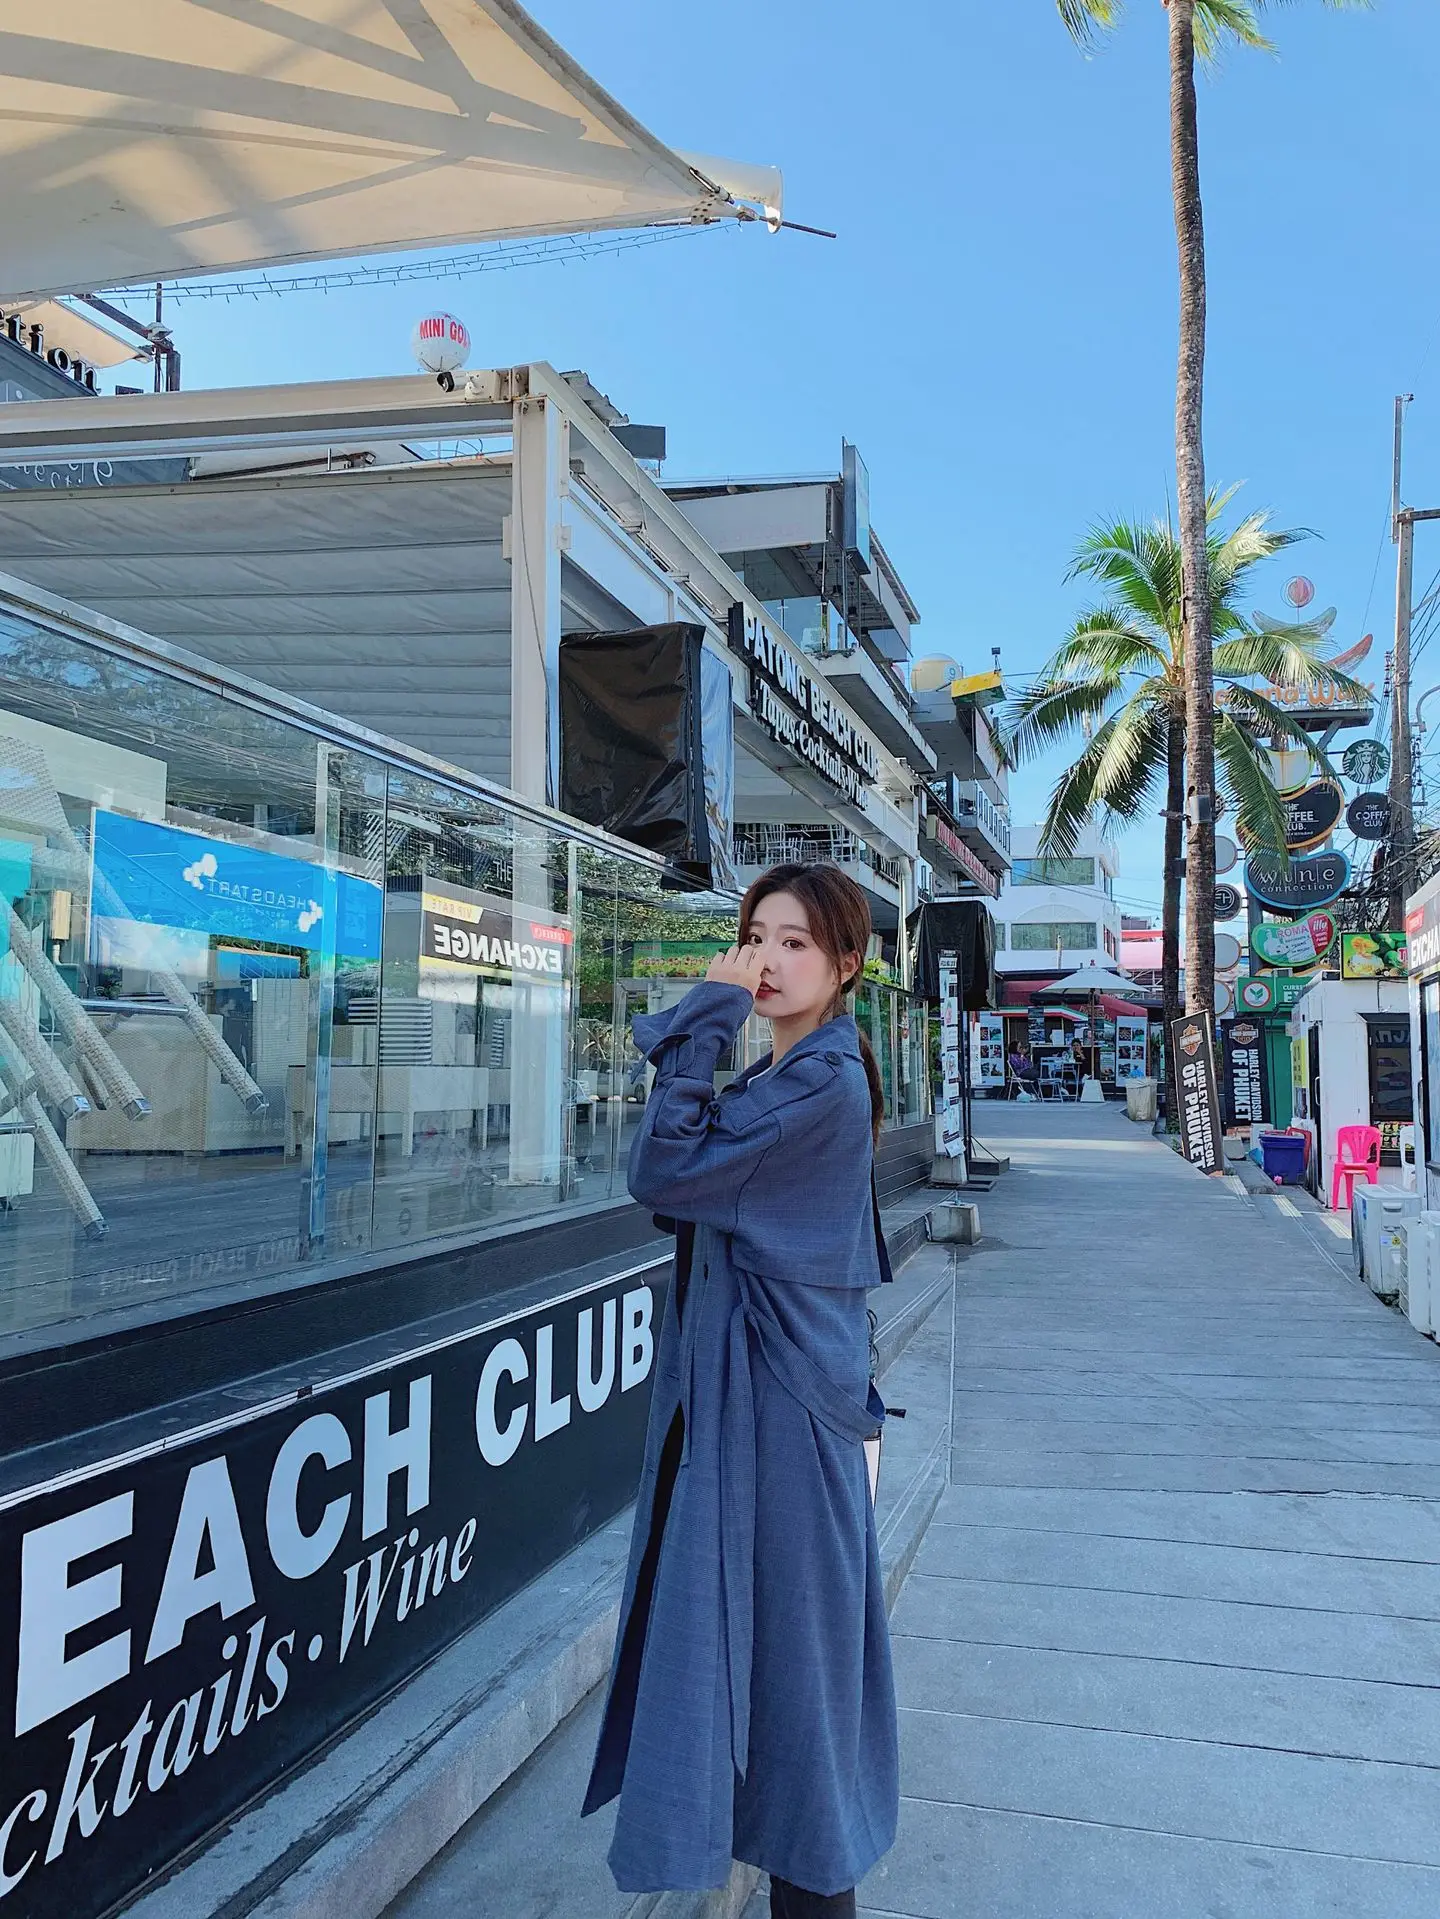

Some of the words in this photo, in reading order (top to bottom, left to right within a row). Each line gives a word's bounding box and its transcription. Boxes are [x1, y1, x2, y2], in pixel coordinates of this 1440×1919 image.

[420, 319, 444, 339] MINI
[743, 614, 807, 710] PATONG
[810, 678, 856, 755] BEACH
[760, 678, 796, 745] Tapas
[799, 719, 846, 787] Cocktails
[1260, 882, 1334, 893] connection
[1277, 925, 1309, 937] ROMA
[1411, 921, 1440, 969] EXCHA
[1182, 1062, 1197, 1089] OF
[1231, 1049, 1249, 1068] OF
[1249, 1048, 1263, 1121] HARLEY-DAVIDSON
[1195, 1060, 1215, 1167] HARLEY-DAVIDSON
[1233, 1068, 1252, 1121] PHUKET
[1184, 1092, 1206, 1171] PHUKET
[16, 1374, 432, 1737] EACH
[476, 1285, 654, 1467] CLUB
[339, 1517, 478, 1663] Wine
